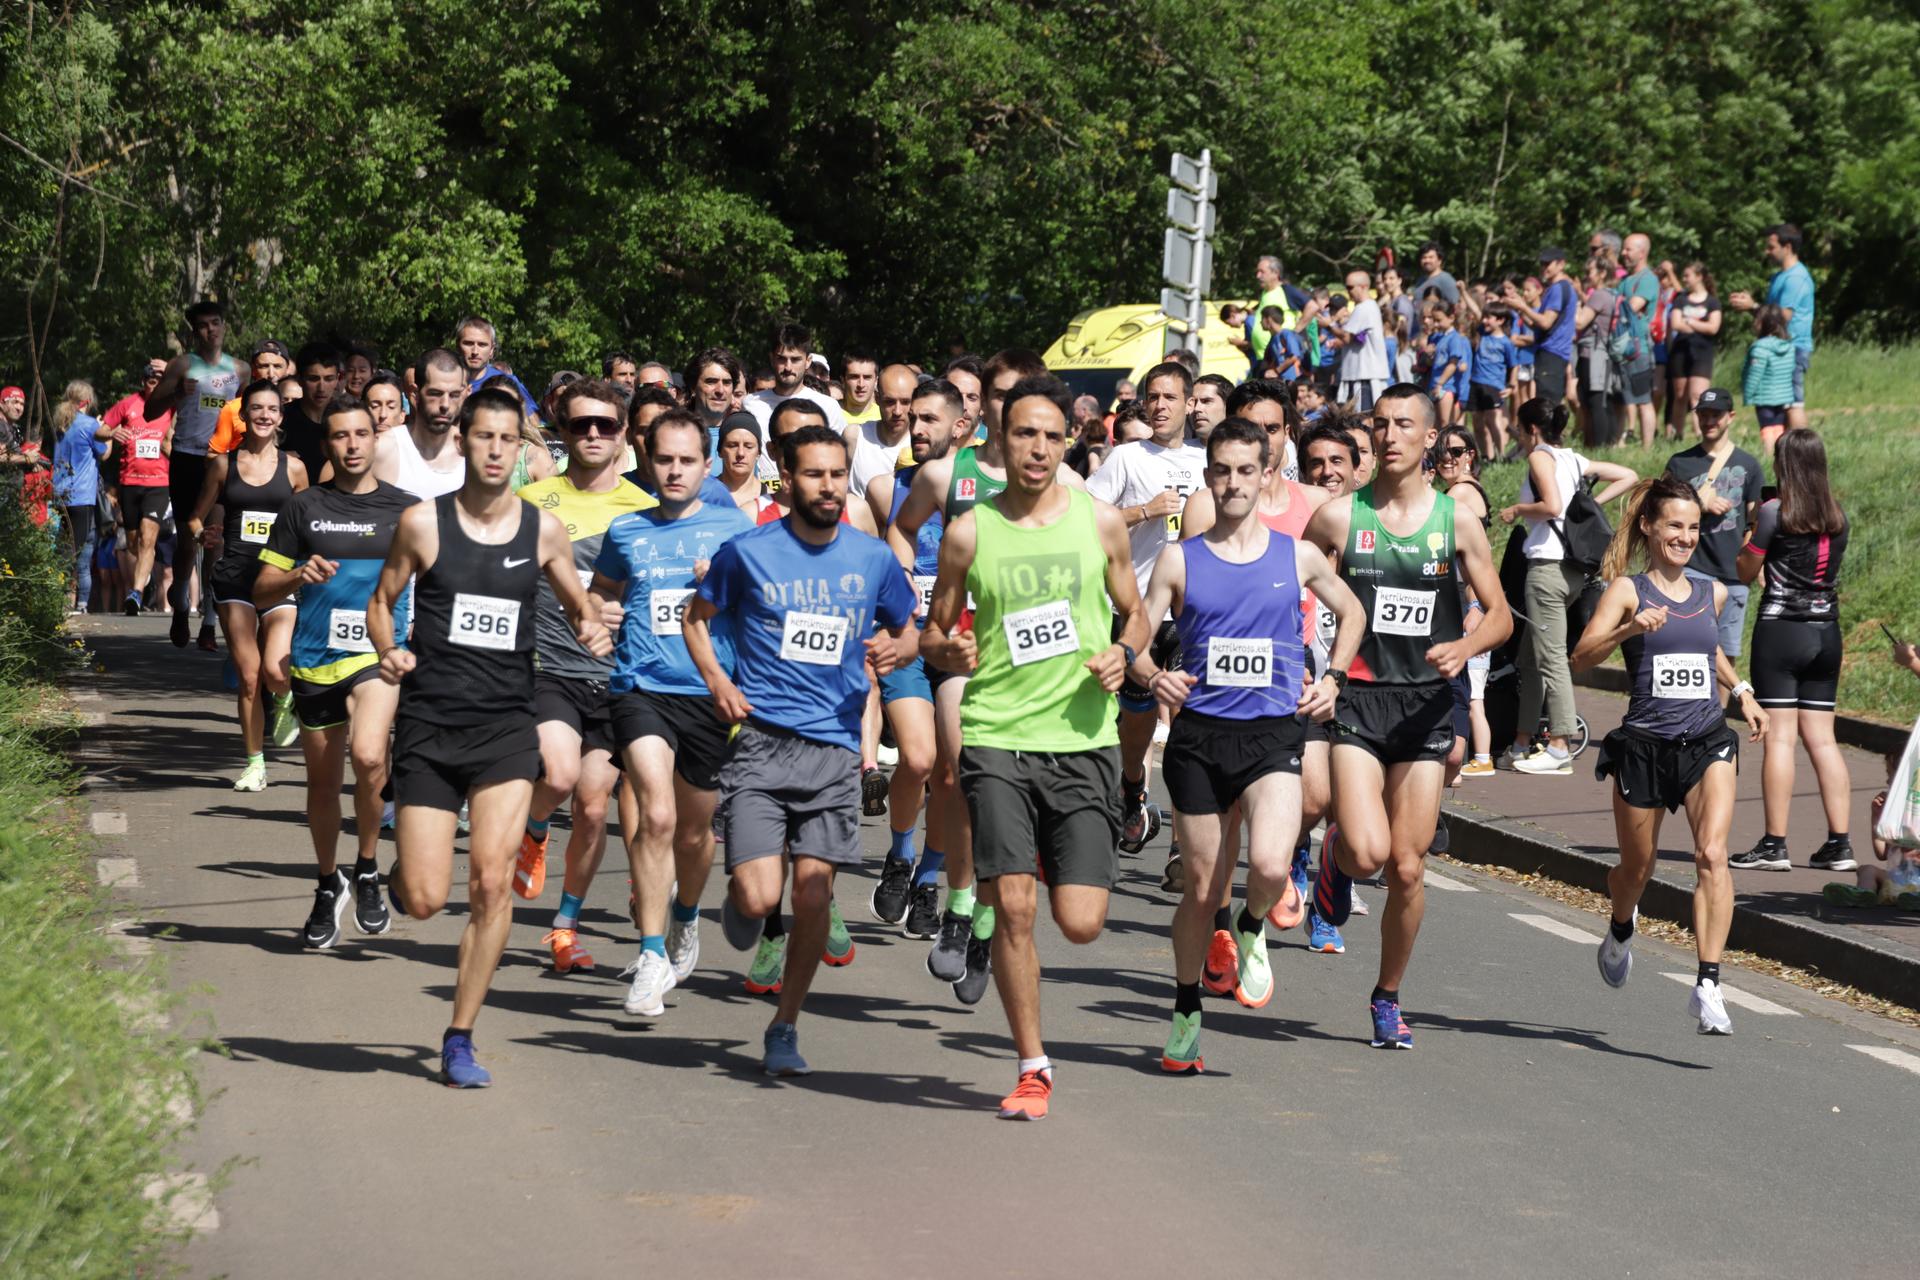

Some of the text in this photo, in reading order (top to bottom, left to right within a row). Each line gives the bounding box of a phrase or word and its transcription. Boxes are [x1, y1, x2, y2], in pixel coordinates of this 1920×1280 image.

[203, 396, 226, 409] 153
[138, 445, 158, 454] 374
[310, 518, 375, 533] Columbus
[460, 611, 510, 636] 396
[1381, 603, 1429, 625] 370
[791, 629, 839, 652] 403
[1016, 619, 1070, 650] 362
[1215, 654, 1267, 674] 400
[1660, 668, 1705, 687] 399
